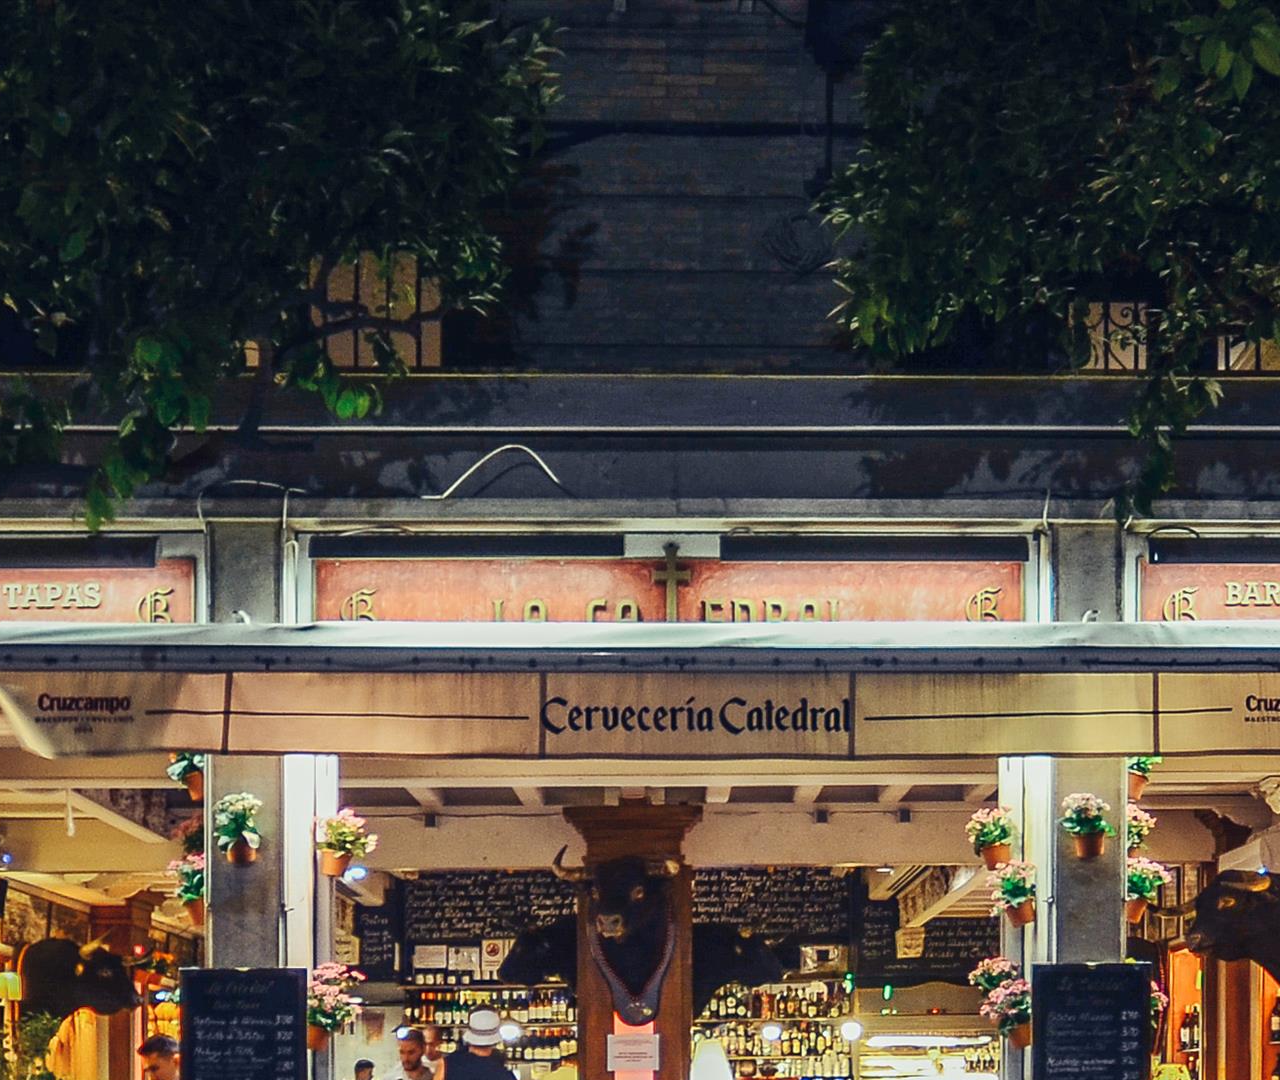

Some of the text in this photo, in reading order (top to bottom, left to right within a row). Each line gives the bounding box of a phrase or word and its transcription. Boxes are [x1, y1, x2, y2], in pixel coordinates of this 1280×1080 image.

[2, 582, 102, 610] TAPAS
[1225, 581, 1280, 607] BAR
[38, 693, 131, 714] Cruzcampo
[542, 696, 850, 734] Cervecería Catedral
